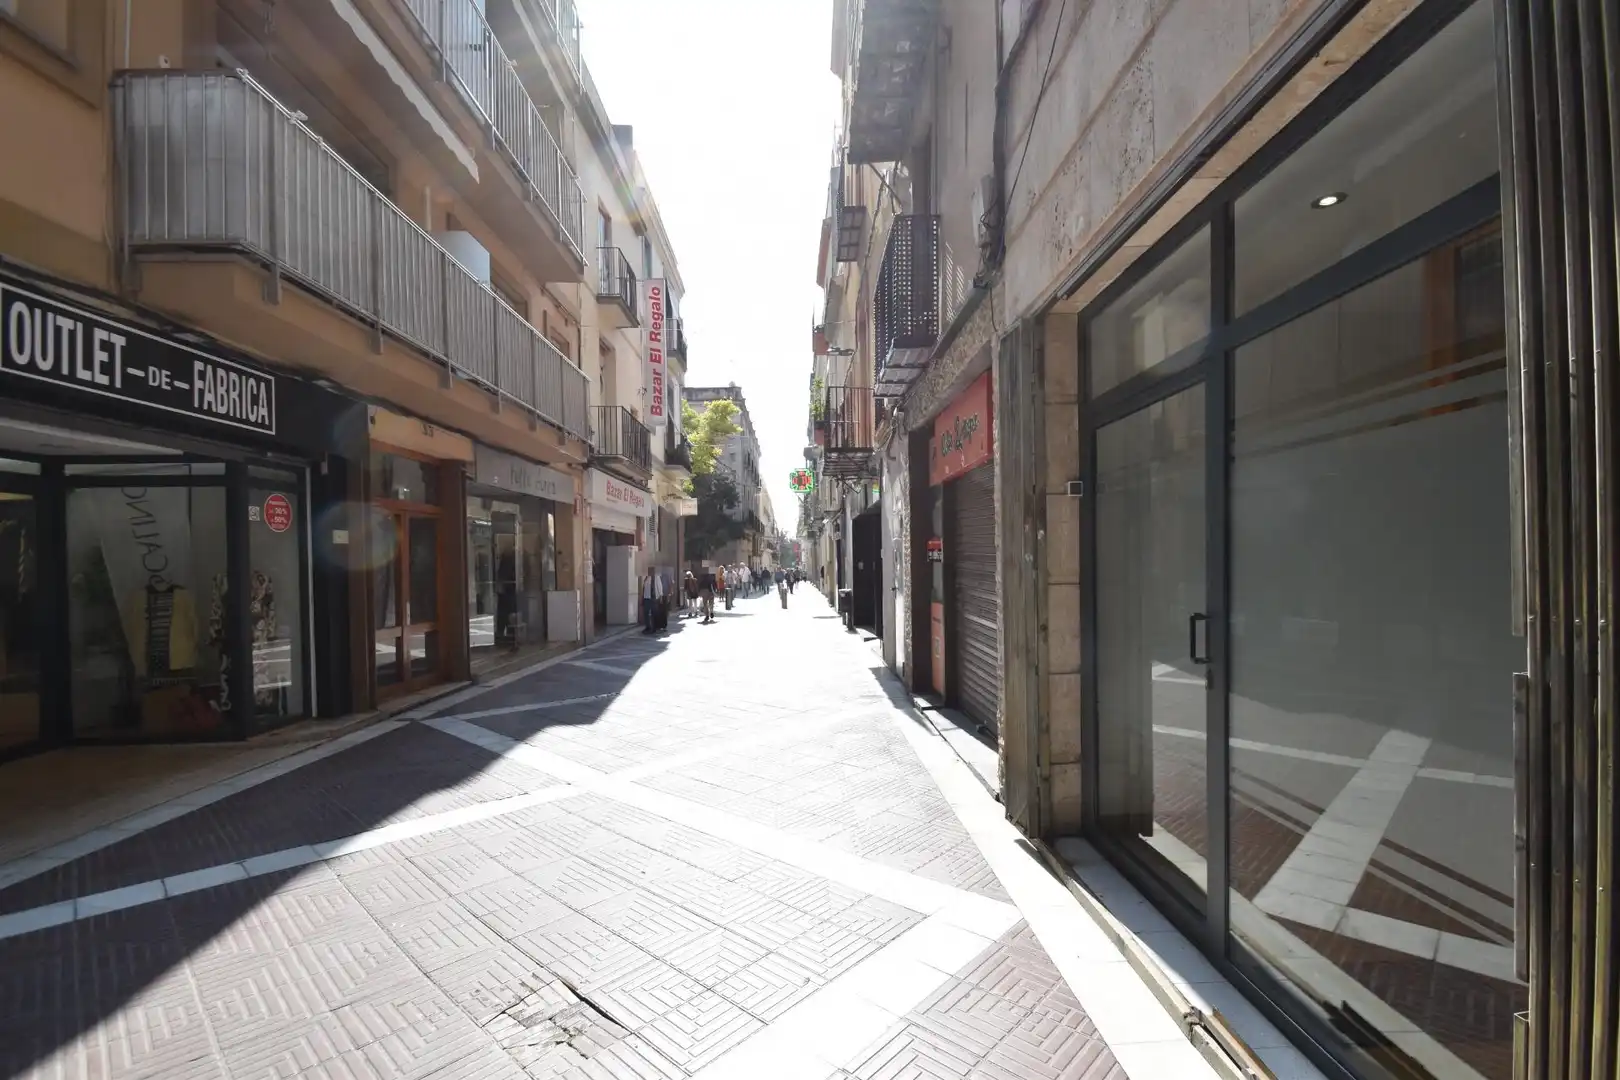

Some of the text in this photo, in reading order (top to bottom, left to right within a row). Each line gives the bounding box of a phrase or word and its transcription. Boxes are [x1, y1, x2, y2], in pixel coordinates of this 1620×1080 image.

[8, 300, 270, 426] OUTLET DE FABRICA
[648, 286, 664, 417] Bazar El Regalo
[606, 479, 622, 500] Bazar
